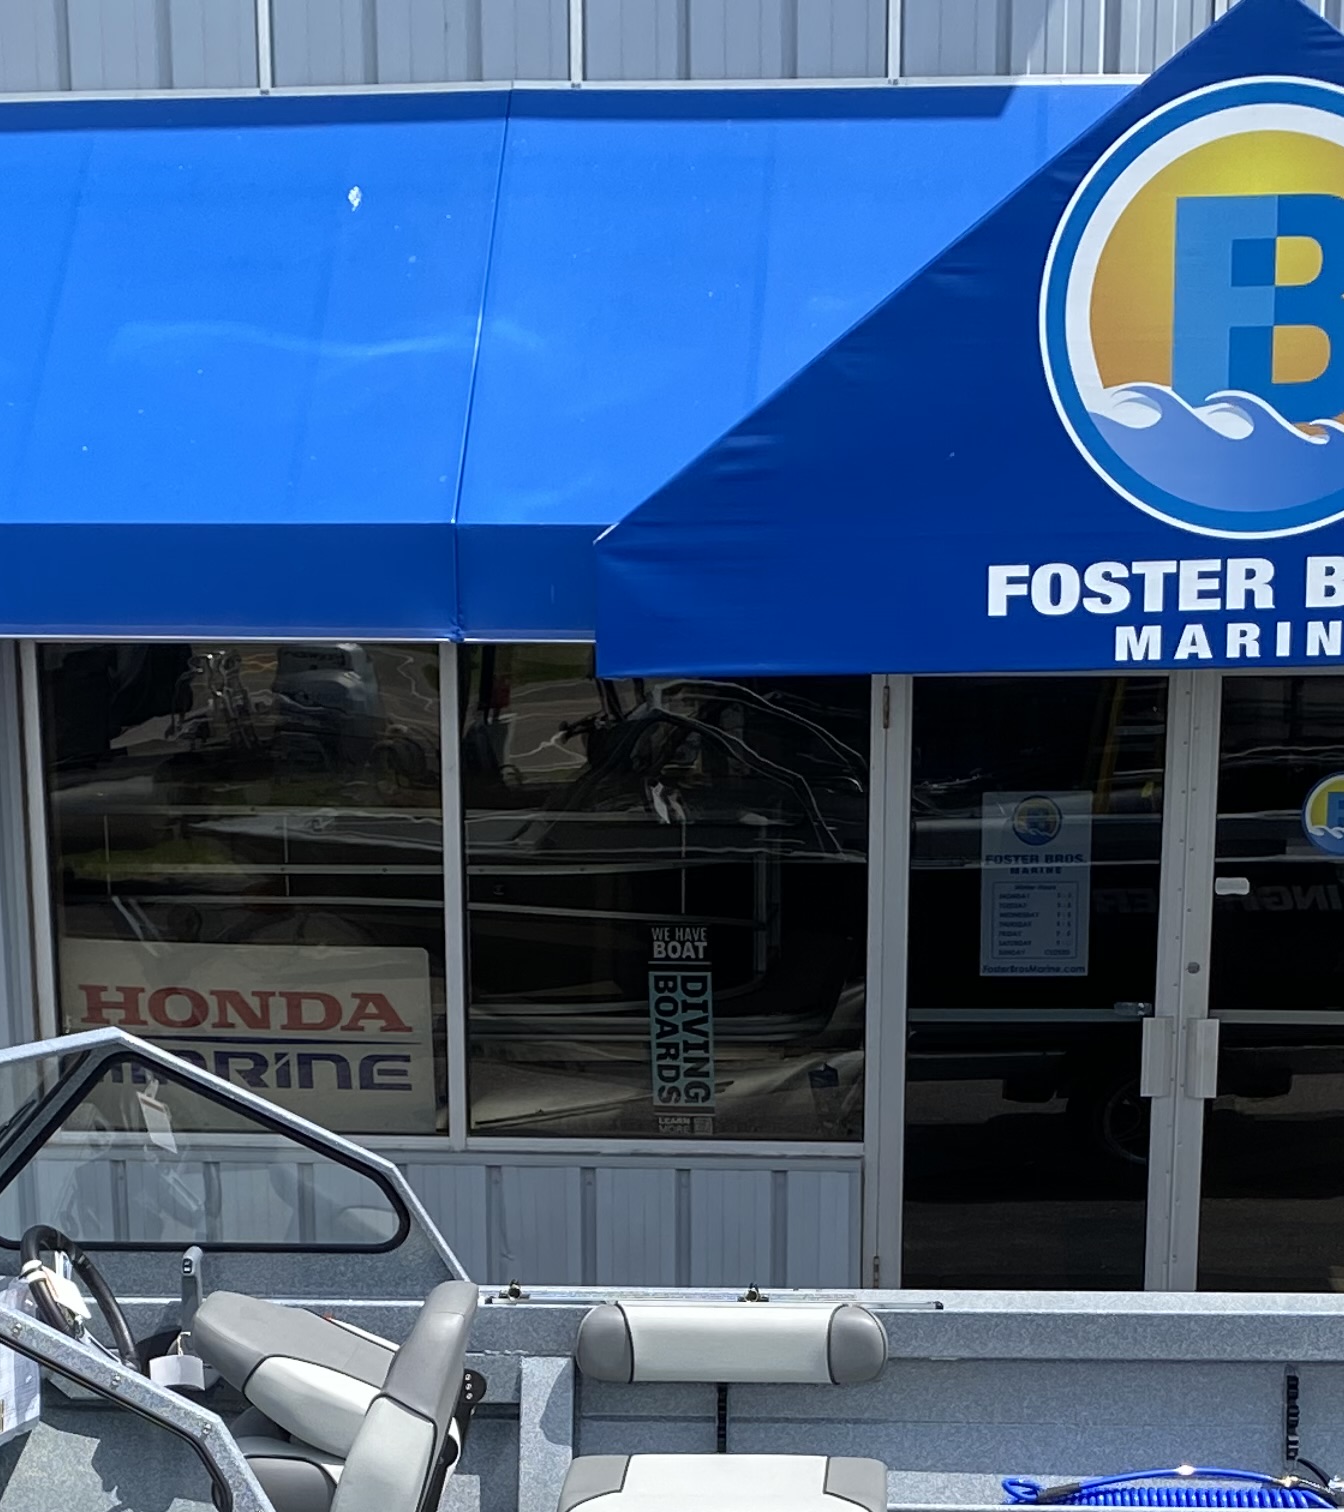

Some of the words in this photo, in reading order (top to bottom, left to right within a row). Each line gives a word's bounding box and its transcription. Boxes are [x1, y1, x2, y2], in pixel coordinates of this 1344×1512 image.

[987, 558, 1275, 617] FOSTER
[985, 854, 1039, 864] FOSTER
[652, 928, 670, 941] WE
[675, 928, 707, 941] HAVE
[653, 941, 708, 959] BOAT
[78, 984, 413, 1033] HONDA
[654, 974, 682, 1104] BOARDS
[681, 974, 712, 1103] DIVING
[99, 1049, 413, 1091] RINE
